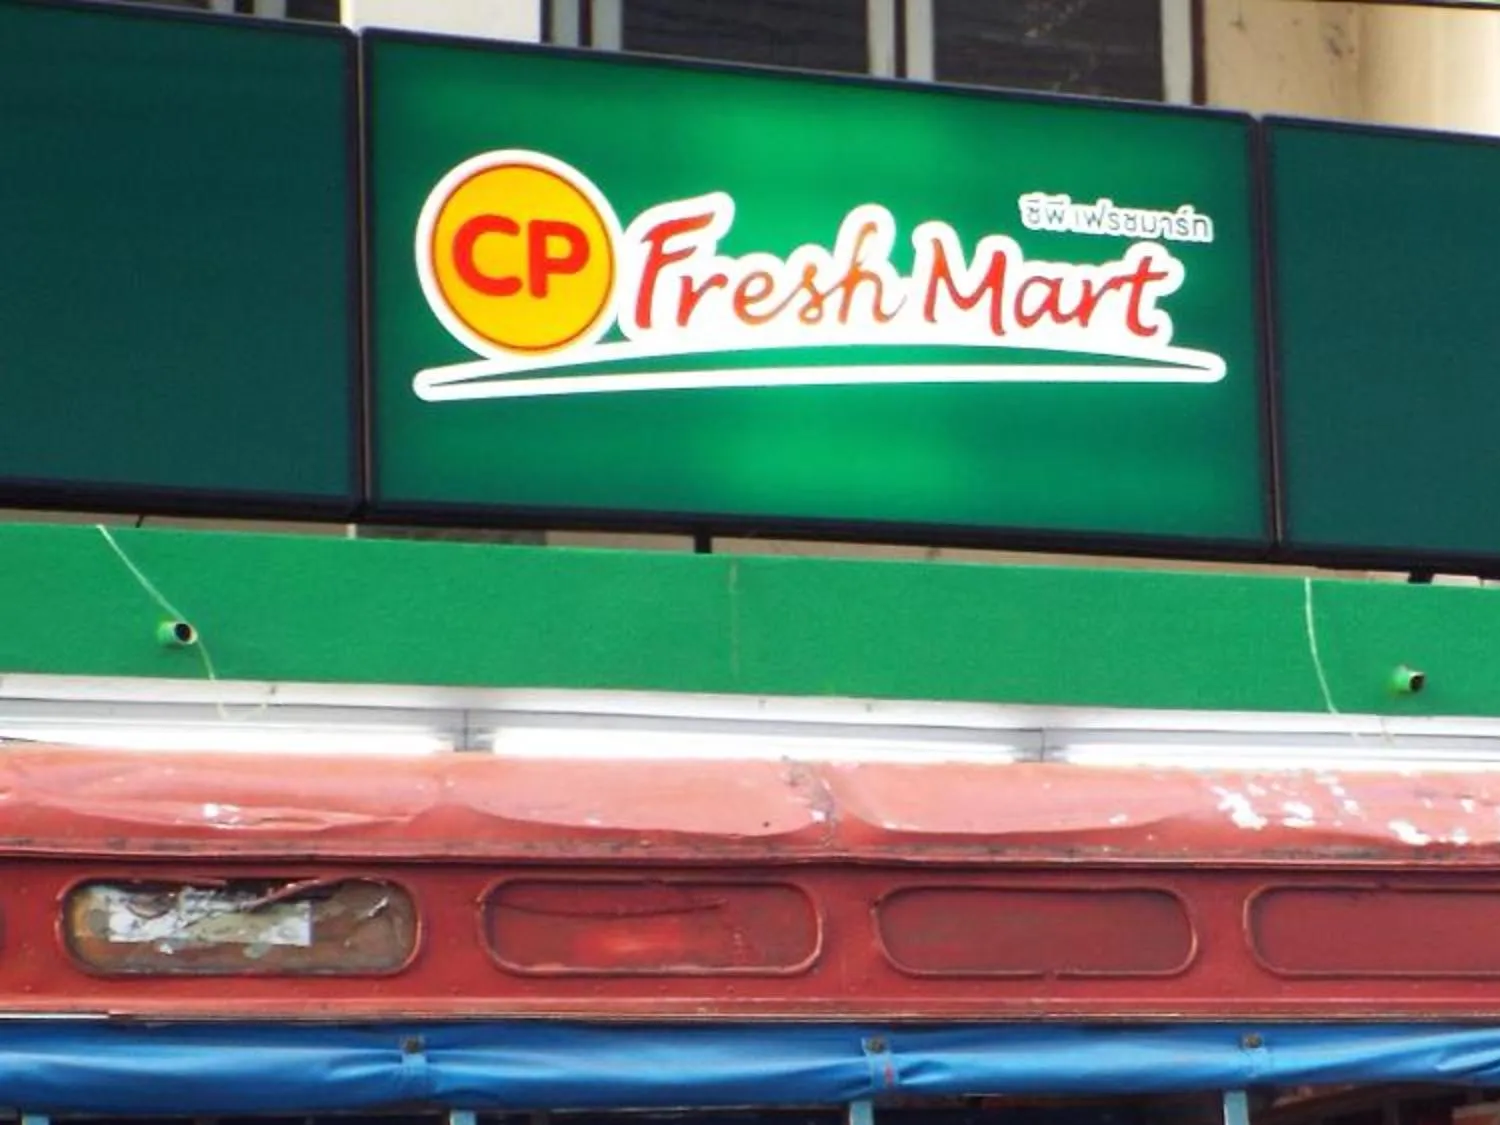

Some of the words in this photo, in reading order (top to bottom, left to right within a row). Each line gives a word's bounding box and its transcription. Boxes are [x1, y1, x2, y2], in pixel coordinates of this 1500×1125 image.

[451, 213, 592, 298] CP
[635, 209, 908, 331] Fresh
[921, 235, 1174, 338] Mart
